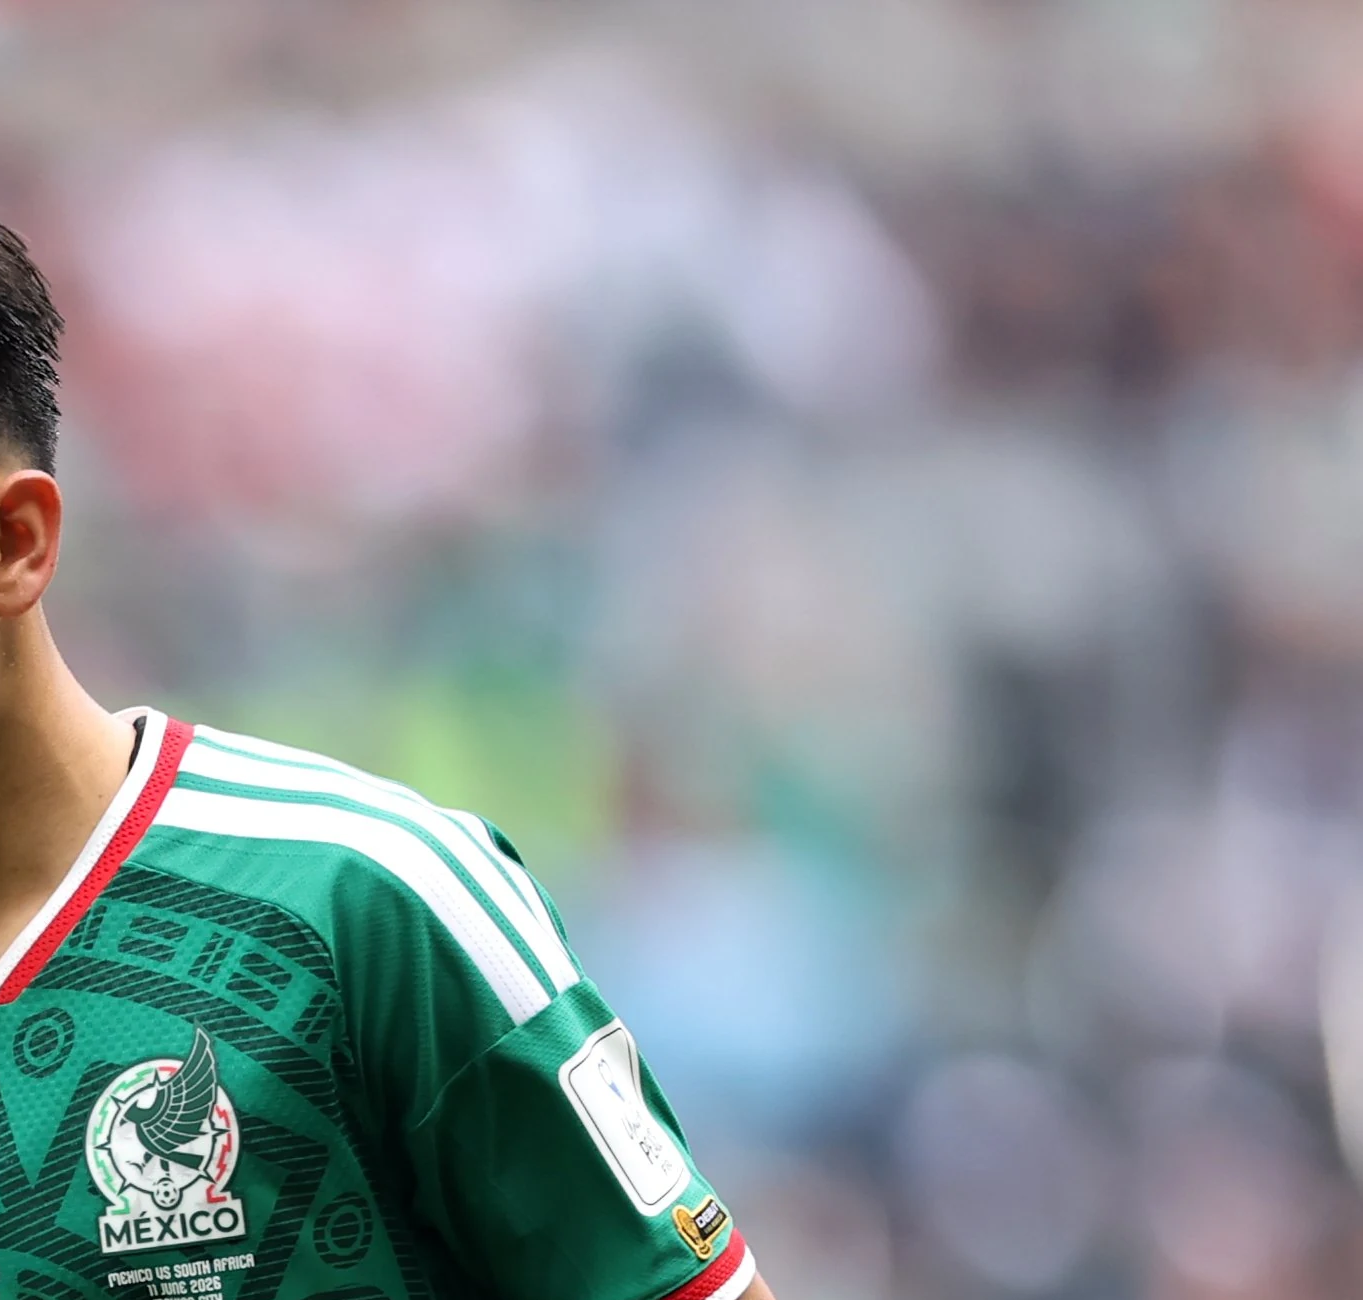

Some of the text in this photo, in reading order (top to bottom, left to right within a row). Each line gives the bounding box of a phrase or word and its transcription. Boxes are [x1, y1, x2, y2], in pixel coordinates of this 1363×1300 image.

[103, 1207, 240, 1248] MÉXICO
[107, 1268, 154, 1288] MEXICO
[173, 1259, 212, 1279] SOUTH
[213, 1253, 255, 1273] AFRICA
[147, 1276, 222, 1297] 11 JUNE 2026
